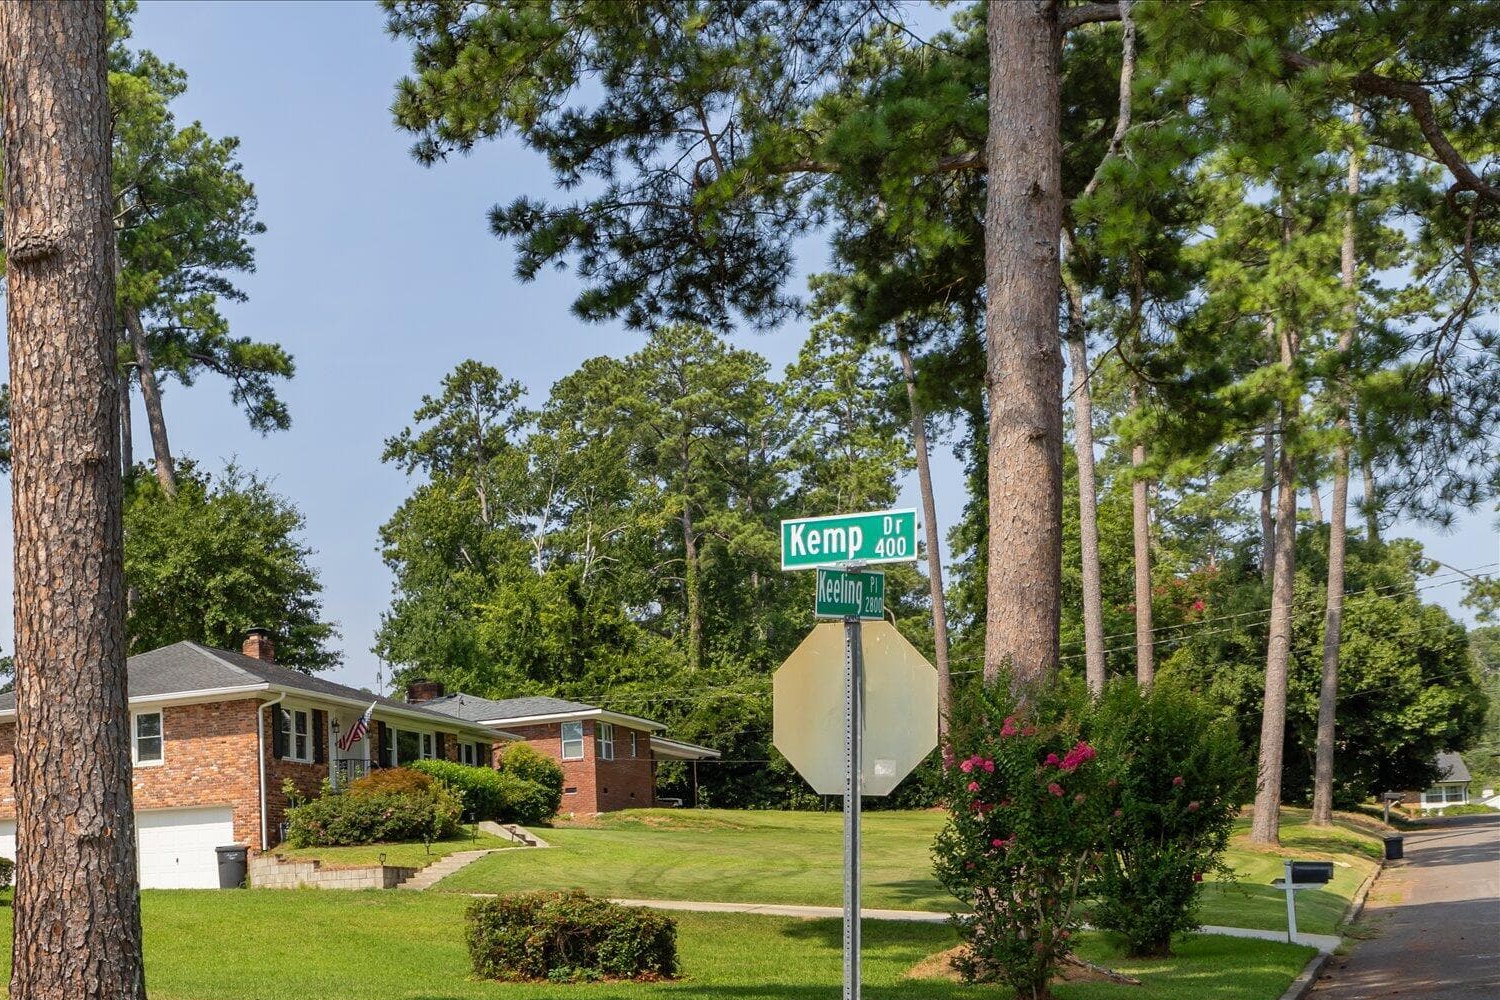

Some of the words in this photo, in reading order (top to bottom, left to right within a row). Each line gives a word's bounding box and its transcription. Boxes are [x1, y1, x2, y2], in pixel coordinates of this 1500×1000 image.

[790, 523, 863, 559] Kemp
[883, 516, 903, 536] Dr
[874, 537, 907, 558] 400
[818, 570, 863, 615] Keeling
[870, 576, 878, 593] Pl
[865, 596, 883, 613] 2800
